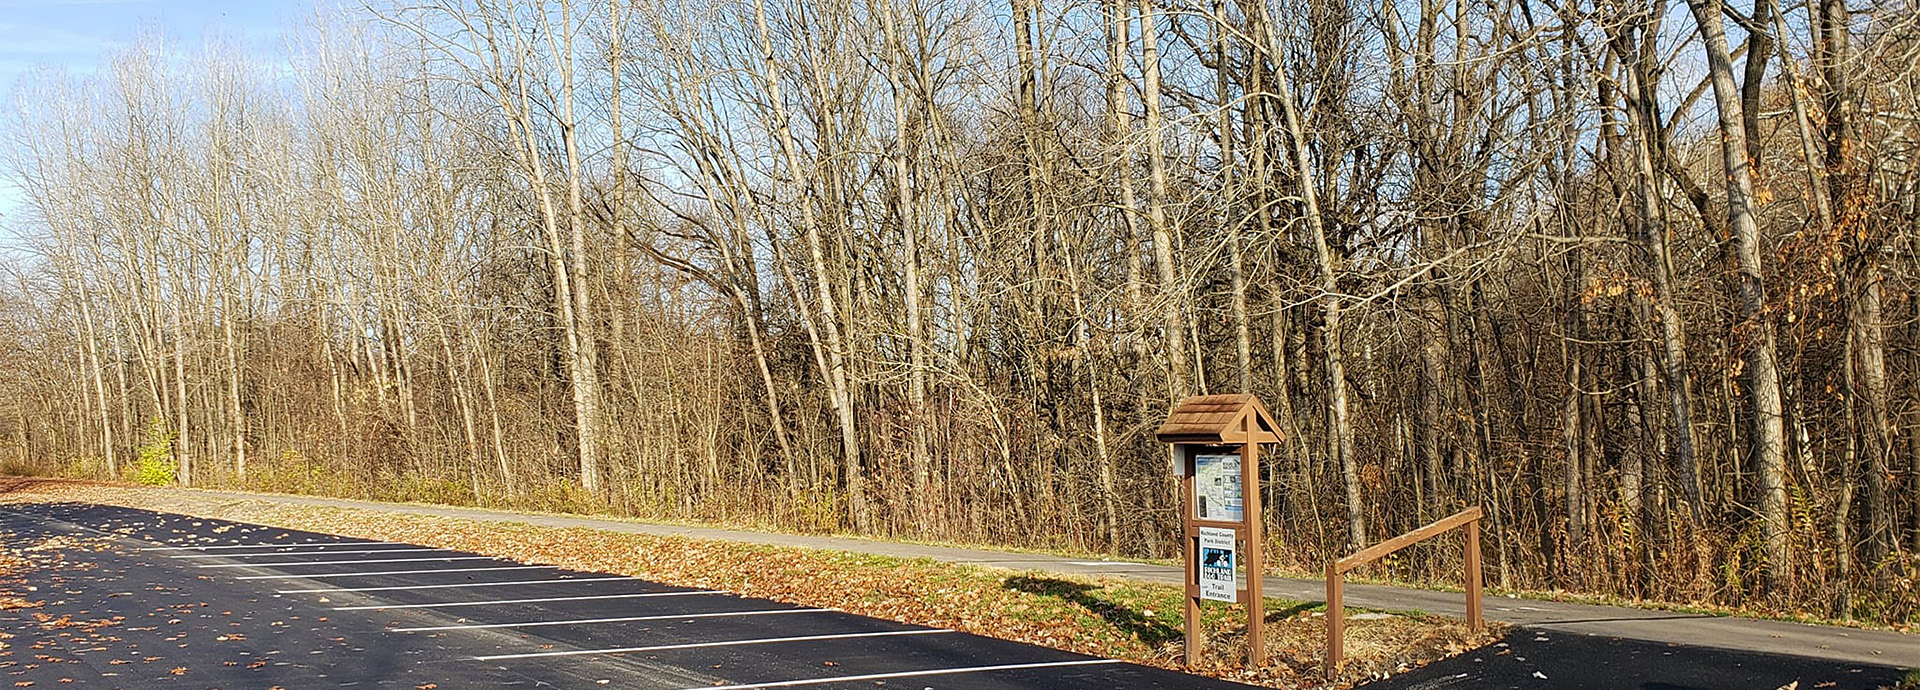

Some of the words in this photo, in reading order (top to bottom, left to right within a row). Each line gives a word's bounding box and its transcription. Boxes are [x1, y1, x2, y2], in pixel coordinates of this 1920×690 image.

[1219, 531, 1233, 539] County
[1205, 567, 1231, 575] RICHLAND
[1206, 590, 1230, 599] Entrance
